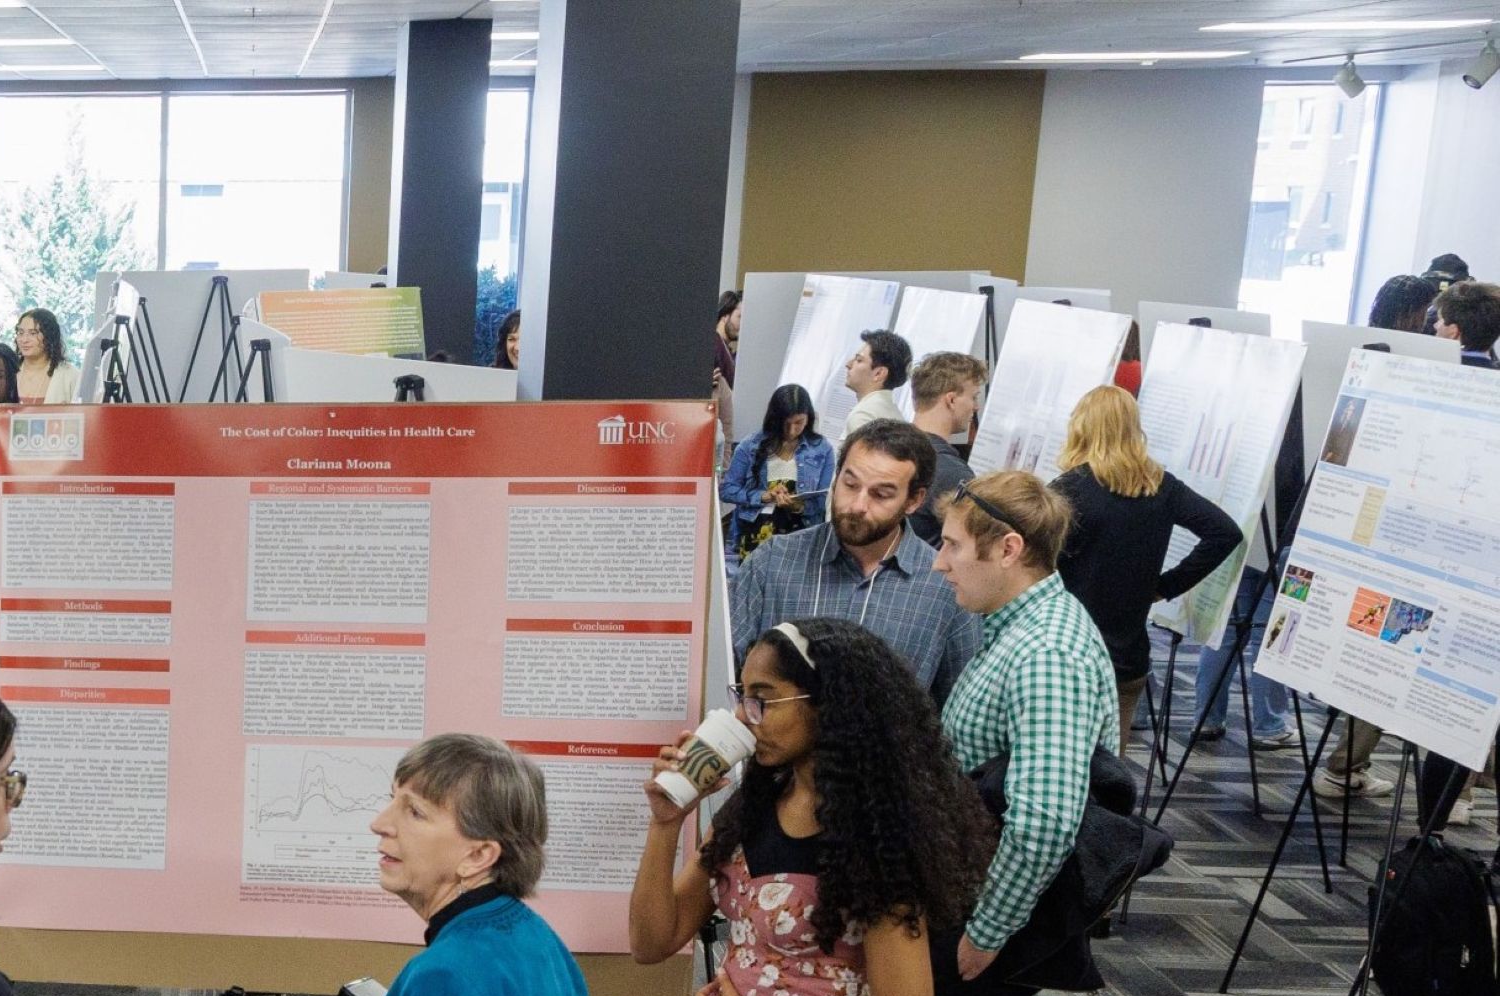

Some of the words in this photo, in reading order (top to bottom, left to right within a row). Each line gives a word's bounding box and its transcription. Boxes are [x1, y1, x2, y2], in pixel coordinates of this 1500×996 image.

[220, 427, 242, 437] The
[244, 428, 270, 438] Cost
[272, 427, 286, 437] of
[287, 427, 324, 438] Color:
[327, 428, 386, 439] Inequities
[389, 428, 401, 438] in
[404, 427, 444, 438] Health
[447, 428, 476, 438] Care
[628, 422, 676, 439] UNC
[287, 459, 342, 469] Clariana
[346, 459, 391, 470] Moona
[59, 484, 115, 493] Introduction
[268, 484, 306, 495] Regional
[307, 485, 325, 493] and
[326, 485, 374, 495] Systematic
[376, 485, 412, 493] Barriers
[577, 484, 626, 493] Discussion
[64, 601, 103, 610] Methods
[573, 622, 624, 631] Conclusion
[295, 634, 341, 643] Additional
[343, 634, 375, 643] Factors
[64, 659, 101, 670] Findings
[60, 689, 106, 700] Disparities
[567, 745, 618, 755] References
